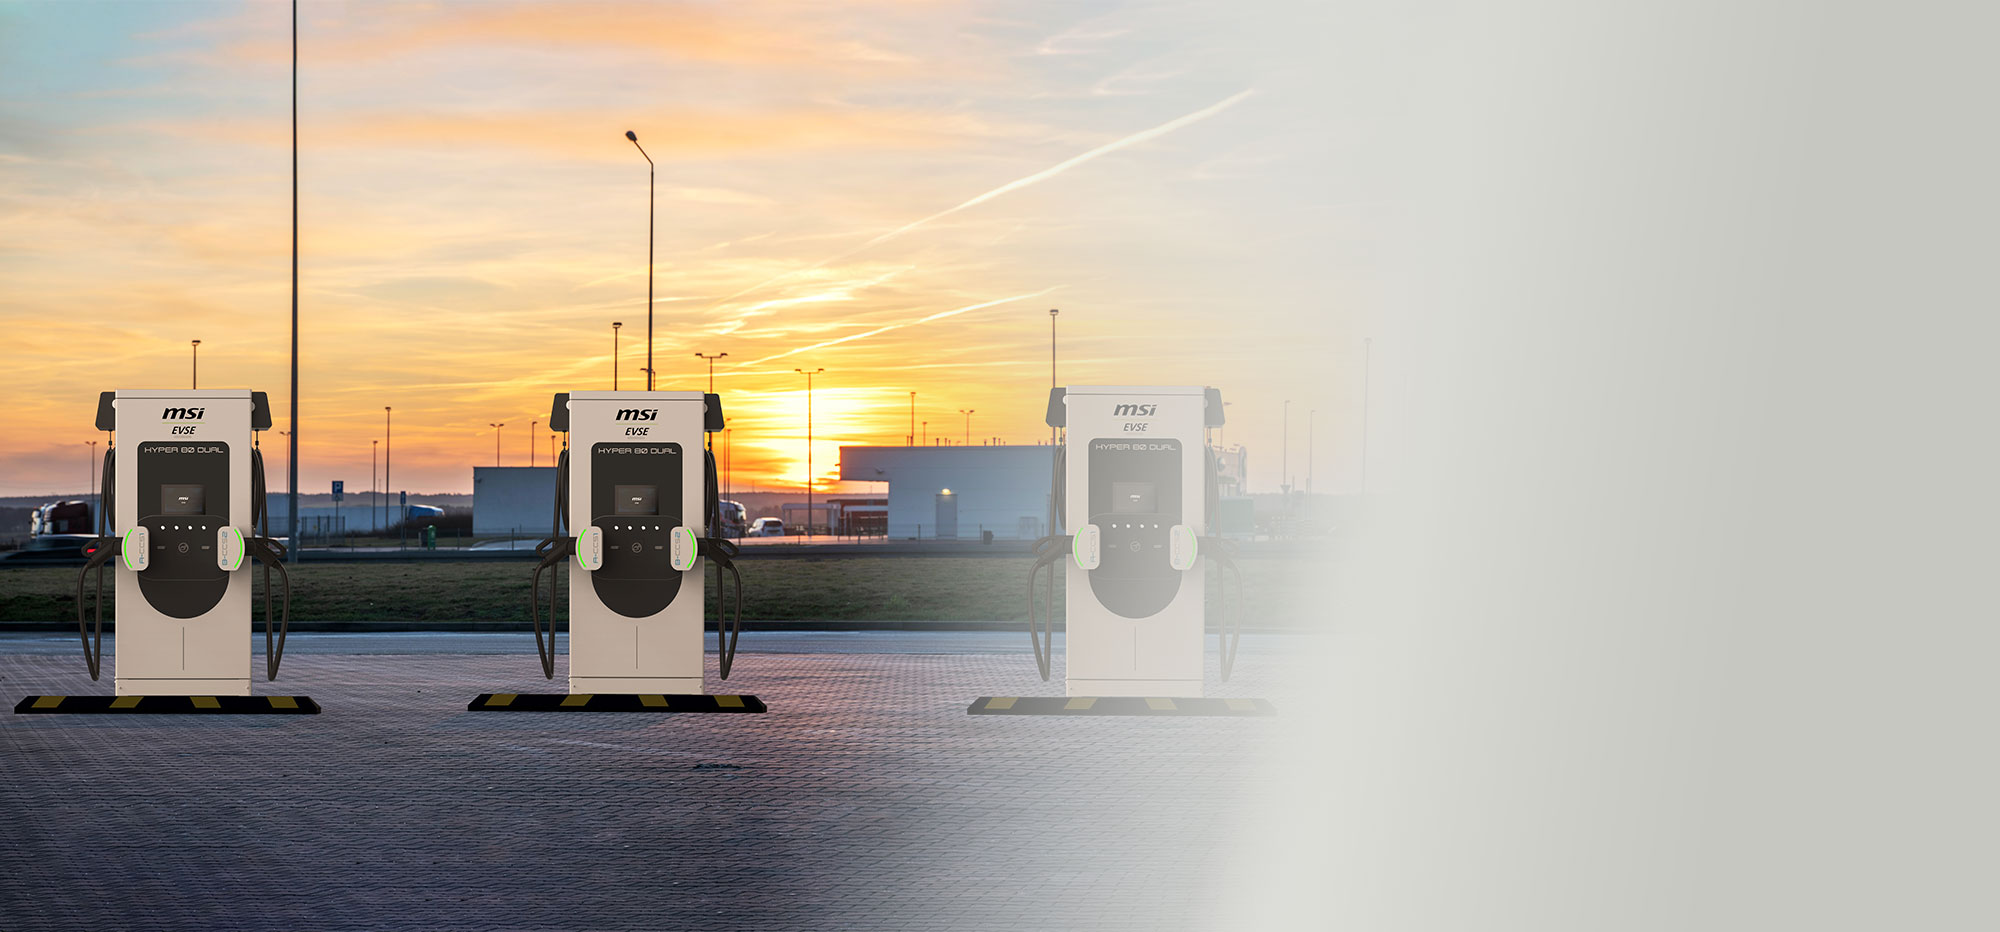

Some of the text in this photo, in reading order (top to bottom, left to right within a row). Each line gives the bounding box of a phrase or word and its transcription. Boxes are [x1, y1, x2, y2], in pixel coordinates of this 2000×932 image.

[162, 407, 205, 420] msi
[615, 409, 659, 421] msi
[1113, 404, 1157, 416] msi
[172, 426, 196, 434] EVSE
[625, 427, 650, 435] EVSE
[1123, 423, 1148, 431] EVSE
[335, 483, 342, 493] P
